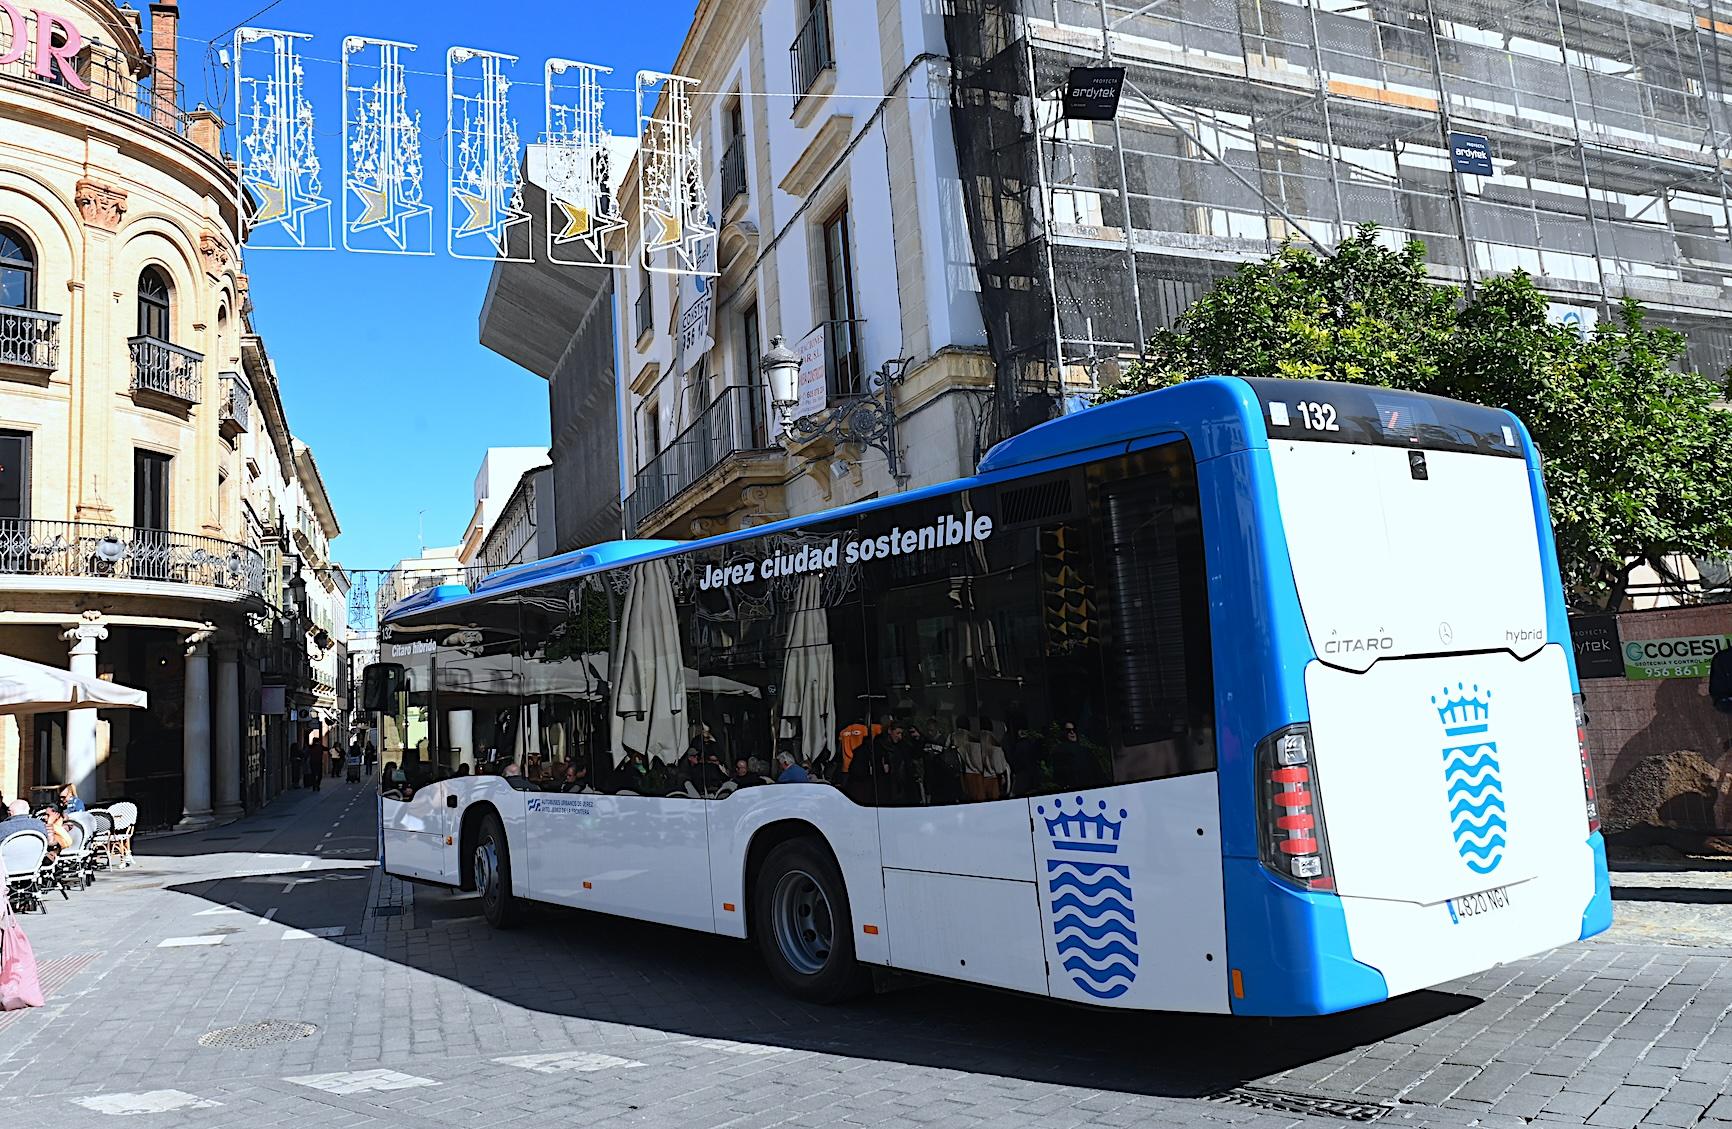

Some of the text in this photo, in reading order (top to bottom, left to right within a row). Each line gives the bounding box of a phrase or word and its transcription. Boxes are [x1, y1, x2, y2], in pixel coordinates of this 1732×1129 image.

[1072, 87, 1116, 100] ardytek
[1455, 147, 1488, 160] ardytek
[1297, 401, 1340, 432] 132
[699, 511, 993, 591] Jerez ciudad sostenible
[382, 626, 392, 641] 132
[1505, 628, 1544, 644] hybrid
[391, 644, 411, 657] Citaro
[1325, 637, 1393, 654] CITARO
[1644, 667, 1670, 678] 956
[1674, 666, 1699, 676] 861
[1456, 886, 1510, 918] 4820 NGV
